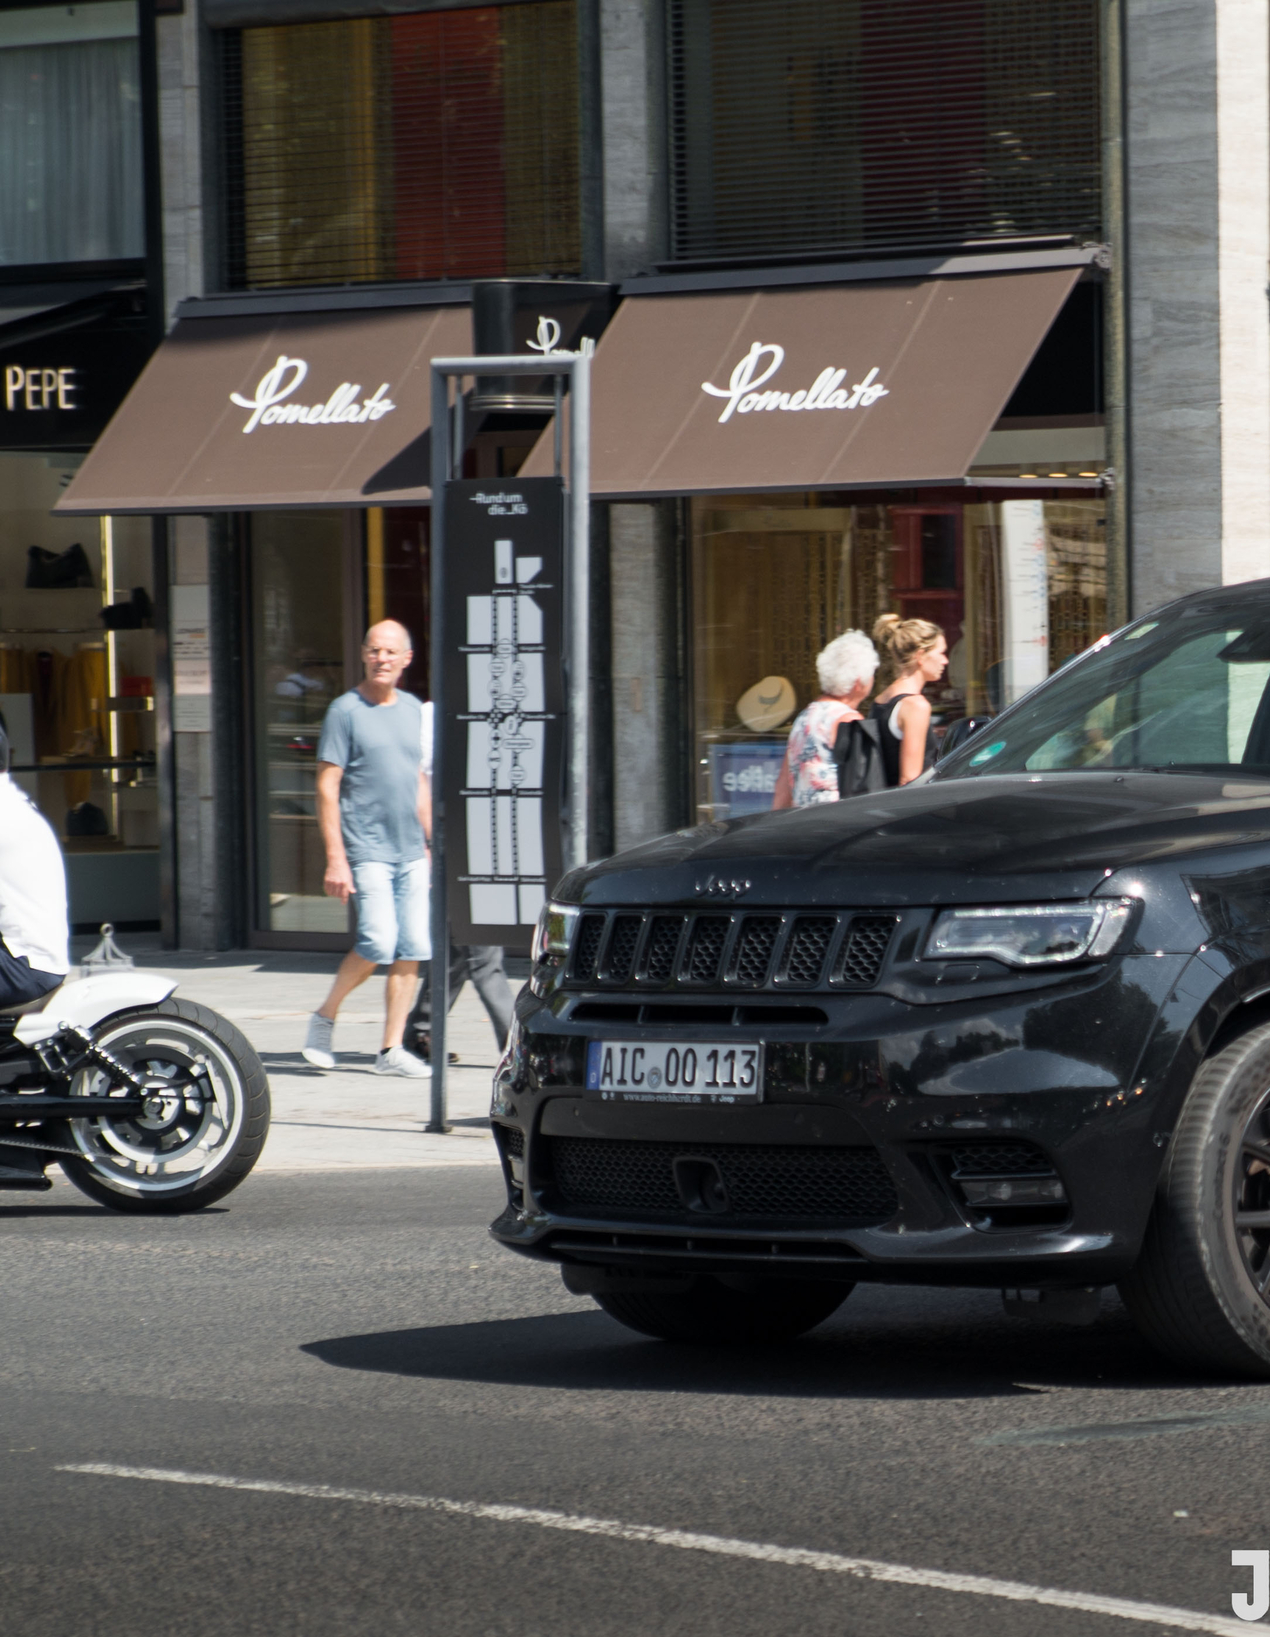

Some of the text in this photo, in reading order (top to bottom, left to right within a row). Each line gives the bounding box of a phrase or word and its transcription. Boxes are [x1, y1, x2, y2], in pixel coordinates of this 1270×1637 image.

[6, 365, 77, 411] PEPE
[230, 355, 396, 434] Pomellato
[701, 341, 890, 423] Pomellato
[601, 1047, 646, 1087] AIC
[705, 1049, 757, 1089] 113
